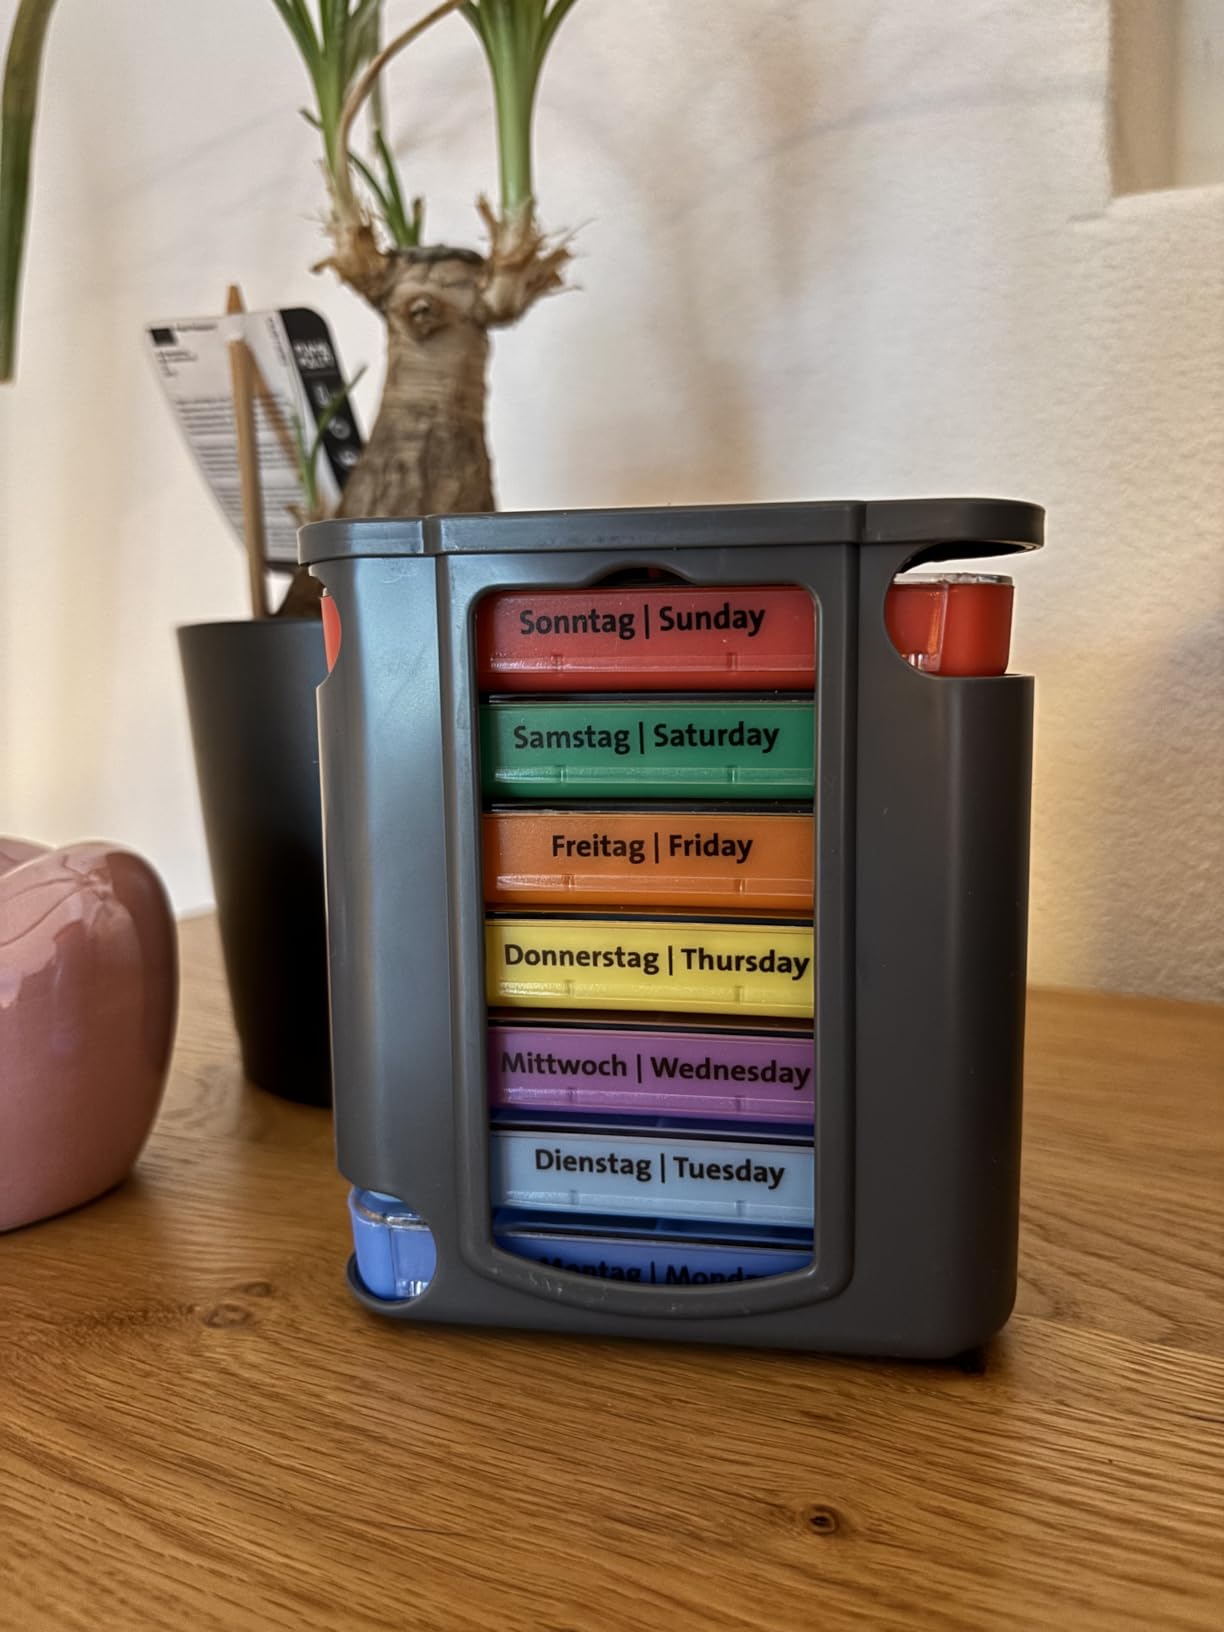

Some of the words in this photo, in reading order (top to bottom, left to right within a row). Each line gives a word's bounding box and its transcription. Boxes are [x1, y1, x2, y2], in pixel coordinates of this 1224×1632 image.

[519, 609, 635, 640] Sonntag
[659, 603, 765, 637] Sunday
[513, 725, 630, 755] Samstag
[654, 721, 780, 753] Saturday
[552, 834, 645, 864] Freitag
[669, 833, 753, 864] Friday
[504, 943, 659, 974] Donnerstag
[681, 948, 810, 980] Thursday
[502, 1052, 627, 1077] Mittwoch
[650, 1056, 811, 1090] Wednesday
[535, 1149, 652, 1182] Dienstag
[673, 1157, 785, 1190] Tuesday
[666, 1264, 766, 1285] Mond
